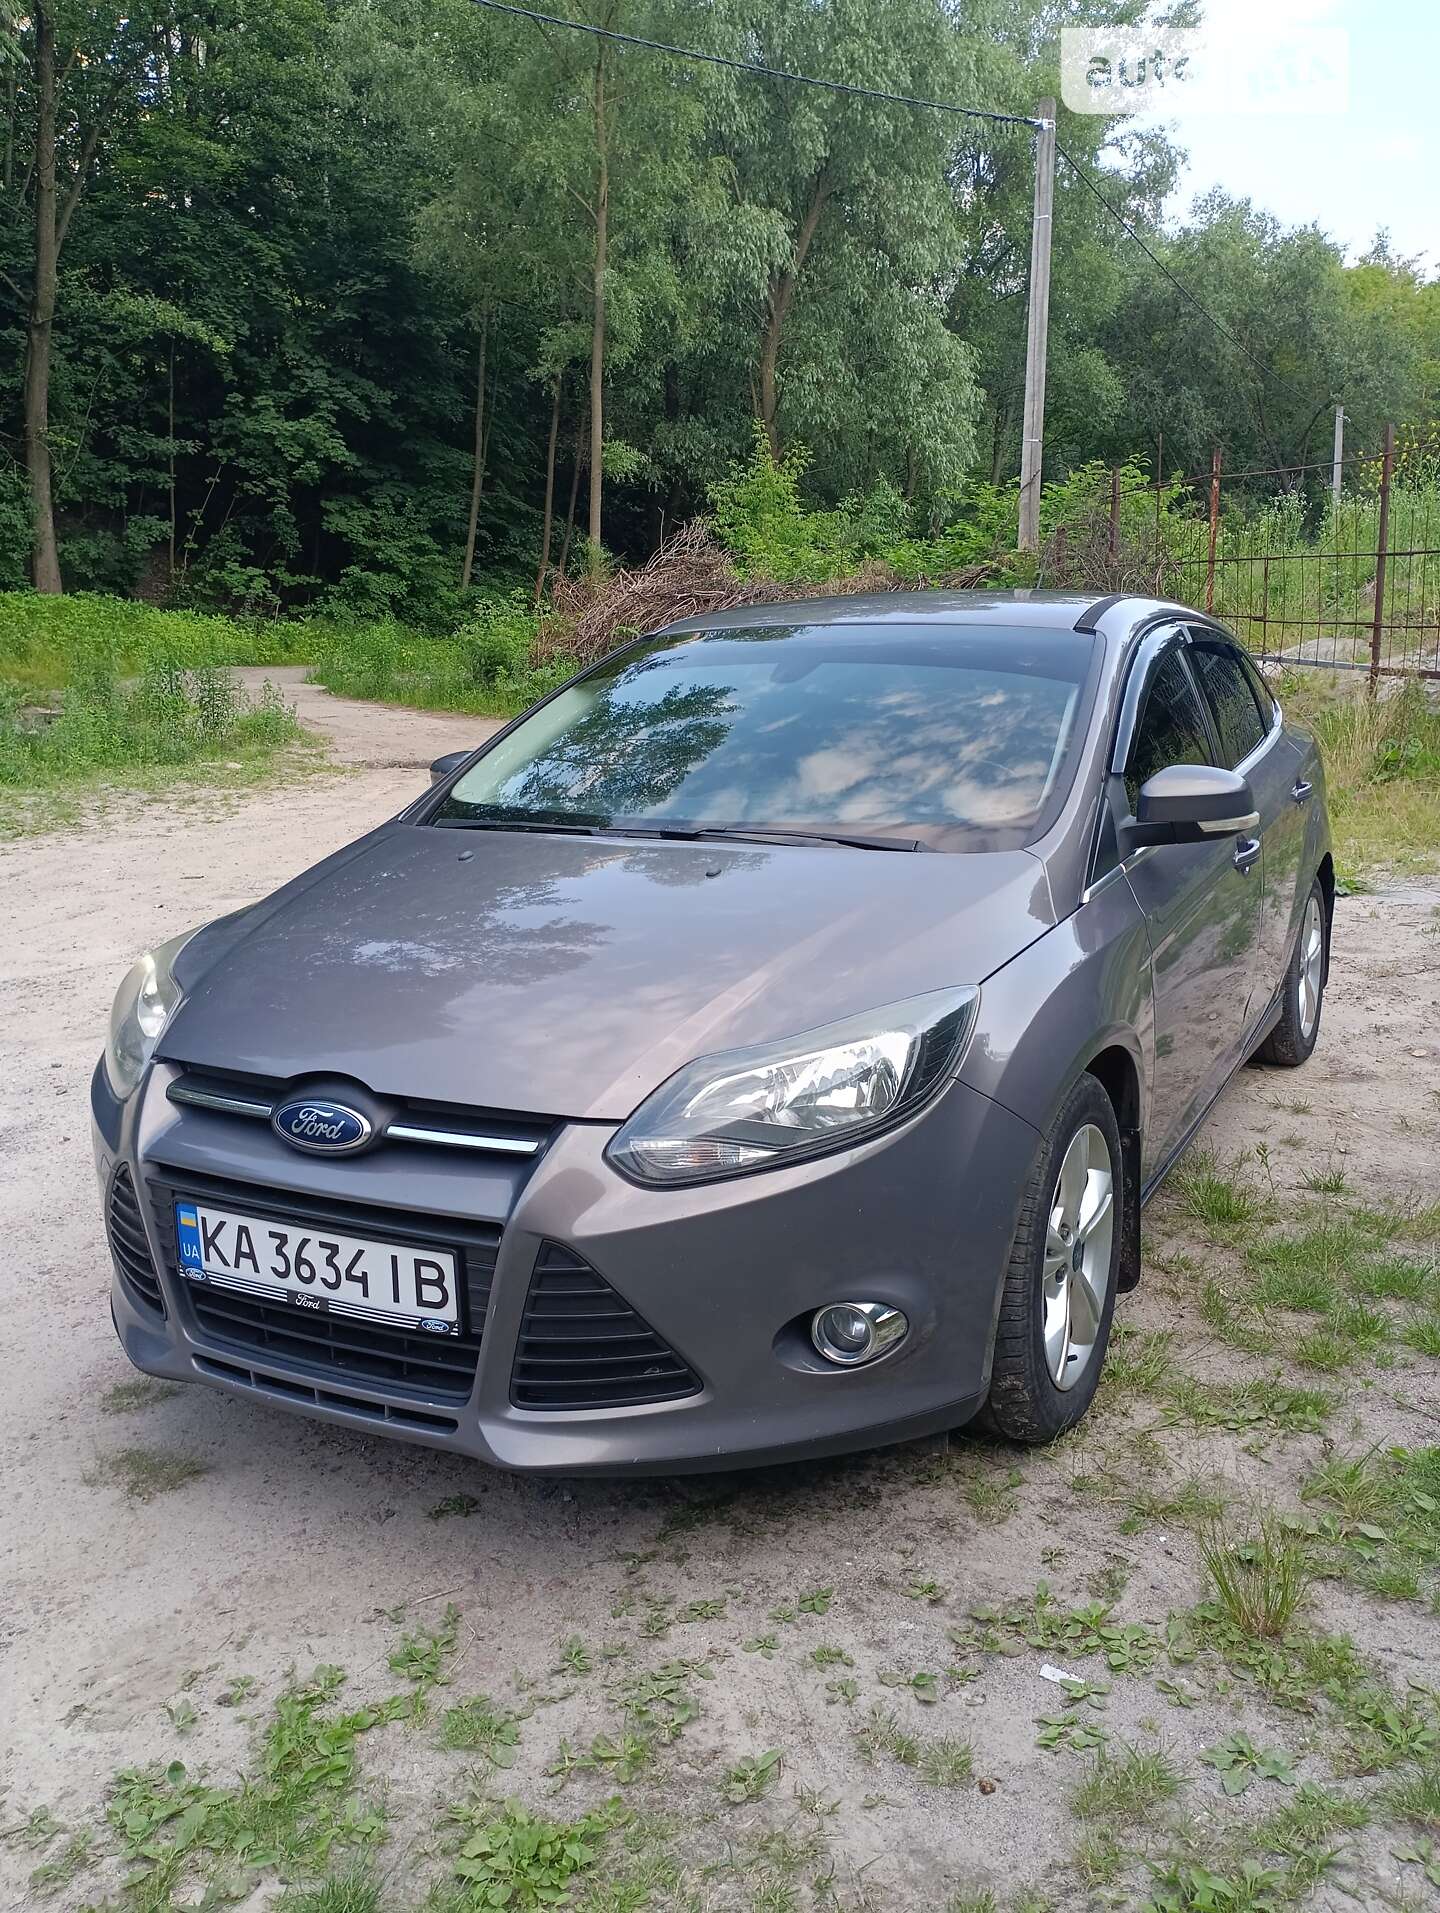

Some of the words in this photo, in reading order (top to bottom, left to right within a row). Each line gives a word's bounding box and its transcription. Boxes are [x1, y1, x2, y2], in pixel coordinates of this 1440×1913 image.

[291, 1107, 346, 1139] Ford
[183, 1242, 200, 1260] UA
[200, 1216, 260, 1274] KA
[267, 1230, 369, 1299] 3634
[390, 1254, 449, 1310] IB
[295, 1293, 320, 1310] Ford
